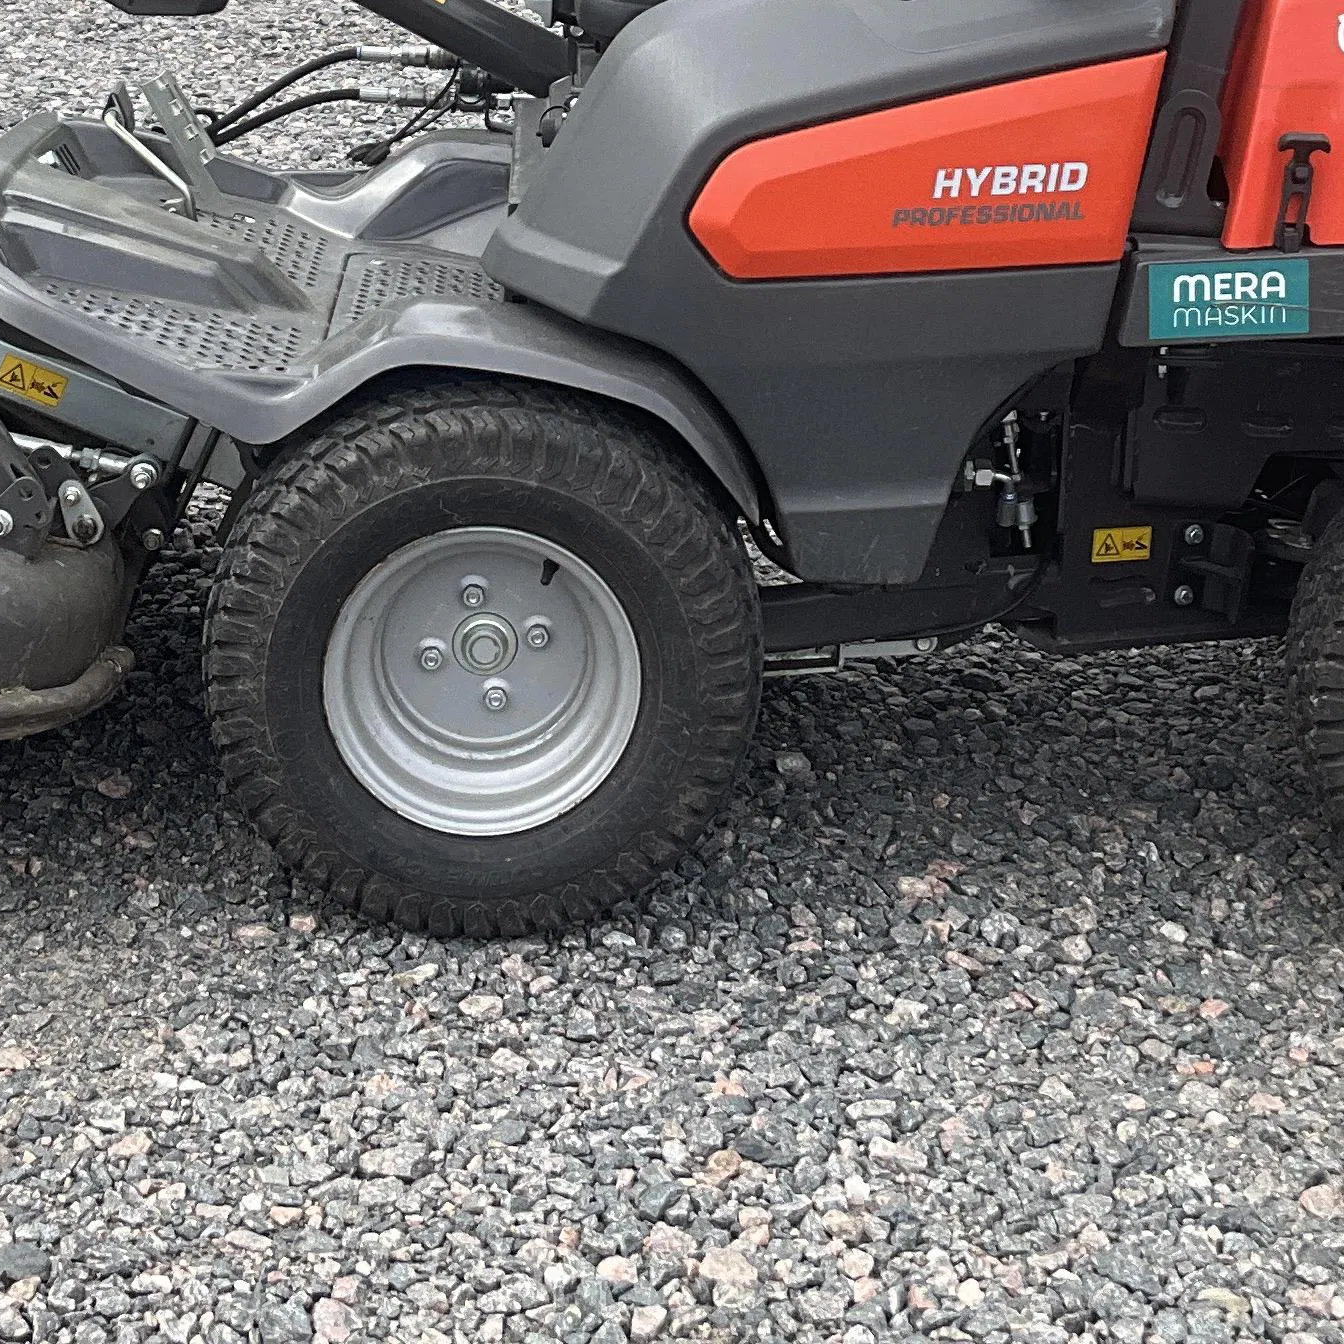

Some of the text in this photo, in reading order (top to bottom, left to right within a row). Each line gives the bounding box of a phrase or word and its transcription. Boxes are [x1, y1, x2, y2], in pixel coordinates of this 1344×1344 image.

[932, 161, 1089, 199] HYBRID
[892, 201, 1084, 227] PROFESSIONAL
[1173, 271, 1286, 303] MERA
[1173, 305, 1286, 328] MASKIN
